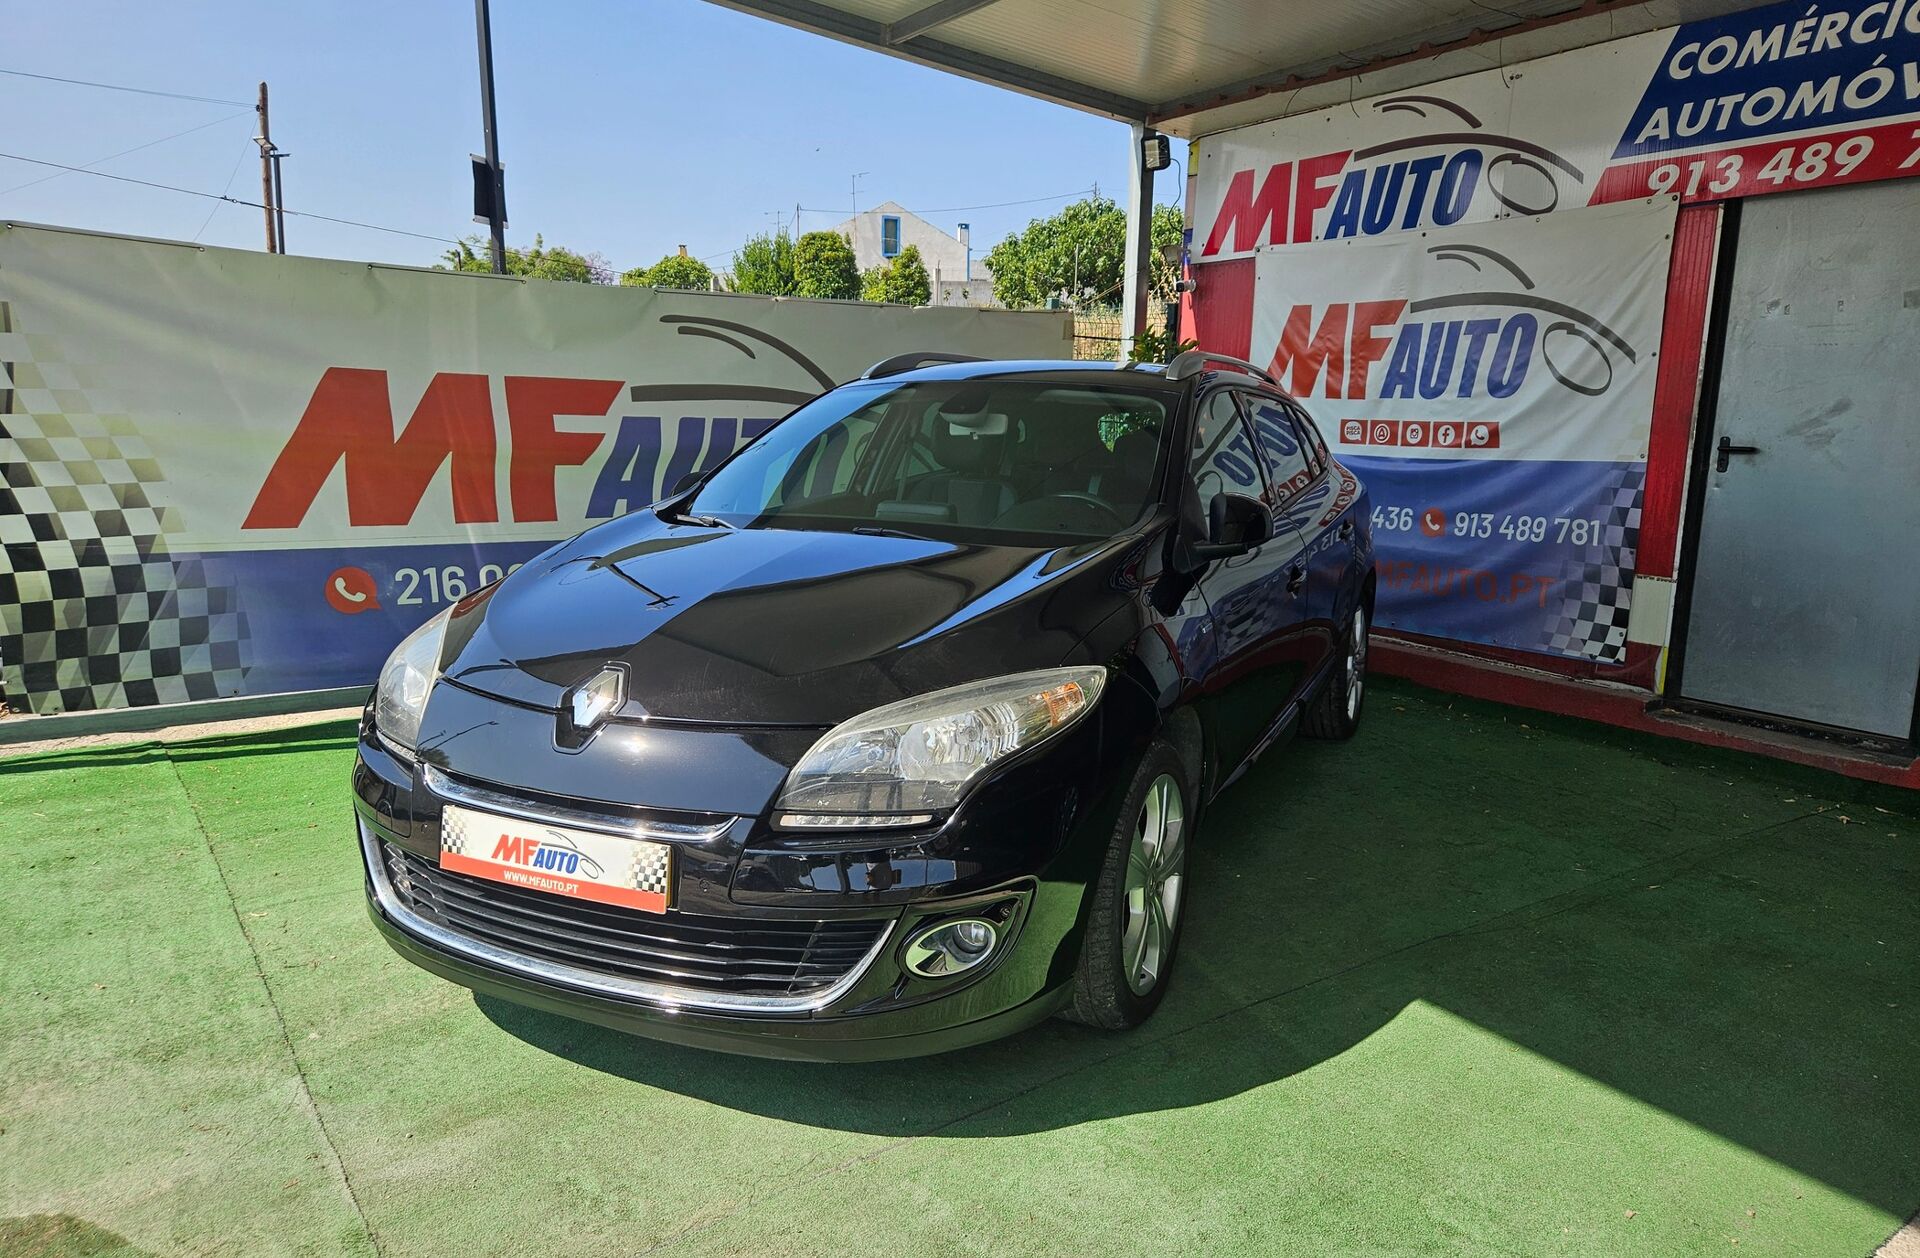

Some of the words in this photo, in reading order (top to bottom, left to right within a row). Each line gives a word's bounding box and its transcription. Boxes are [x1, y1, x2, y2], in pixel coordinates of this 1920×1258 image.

[1648, 154, 1744, 196] 913
[1757, 135, 1875, 185] 489
[1371, 505, 1414, 532] 436
[1454, 512, 1495, 539] 913
[1499, 515, 1547, 543] 489
[1553, 518, 1600, 546] 781
[395, 565, 468, 605] 216
[504, 870, 579, 894] WWW.MFAUTO.PT
